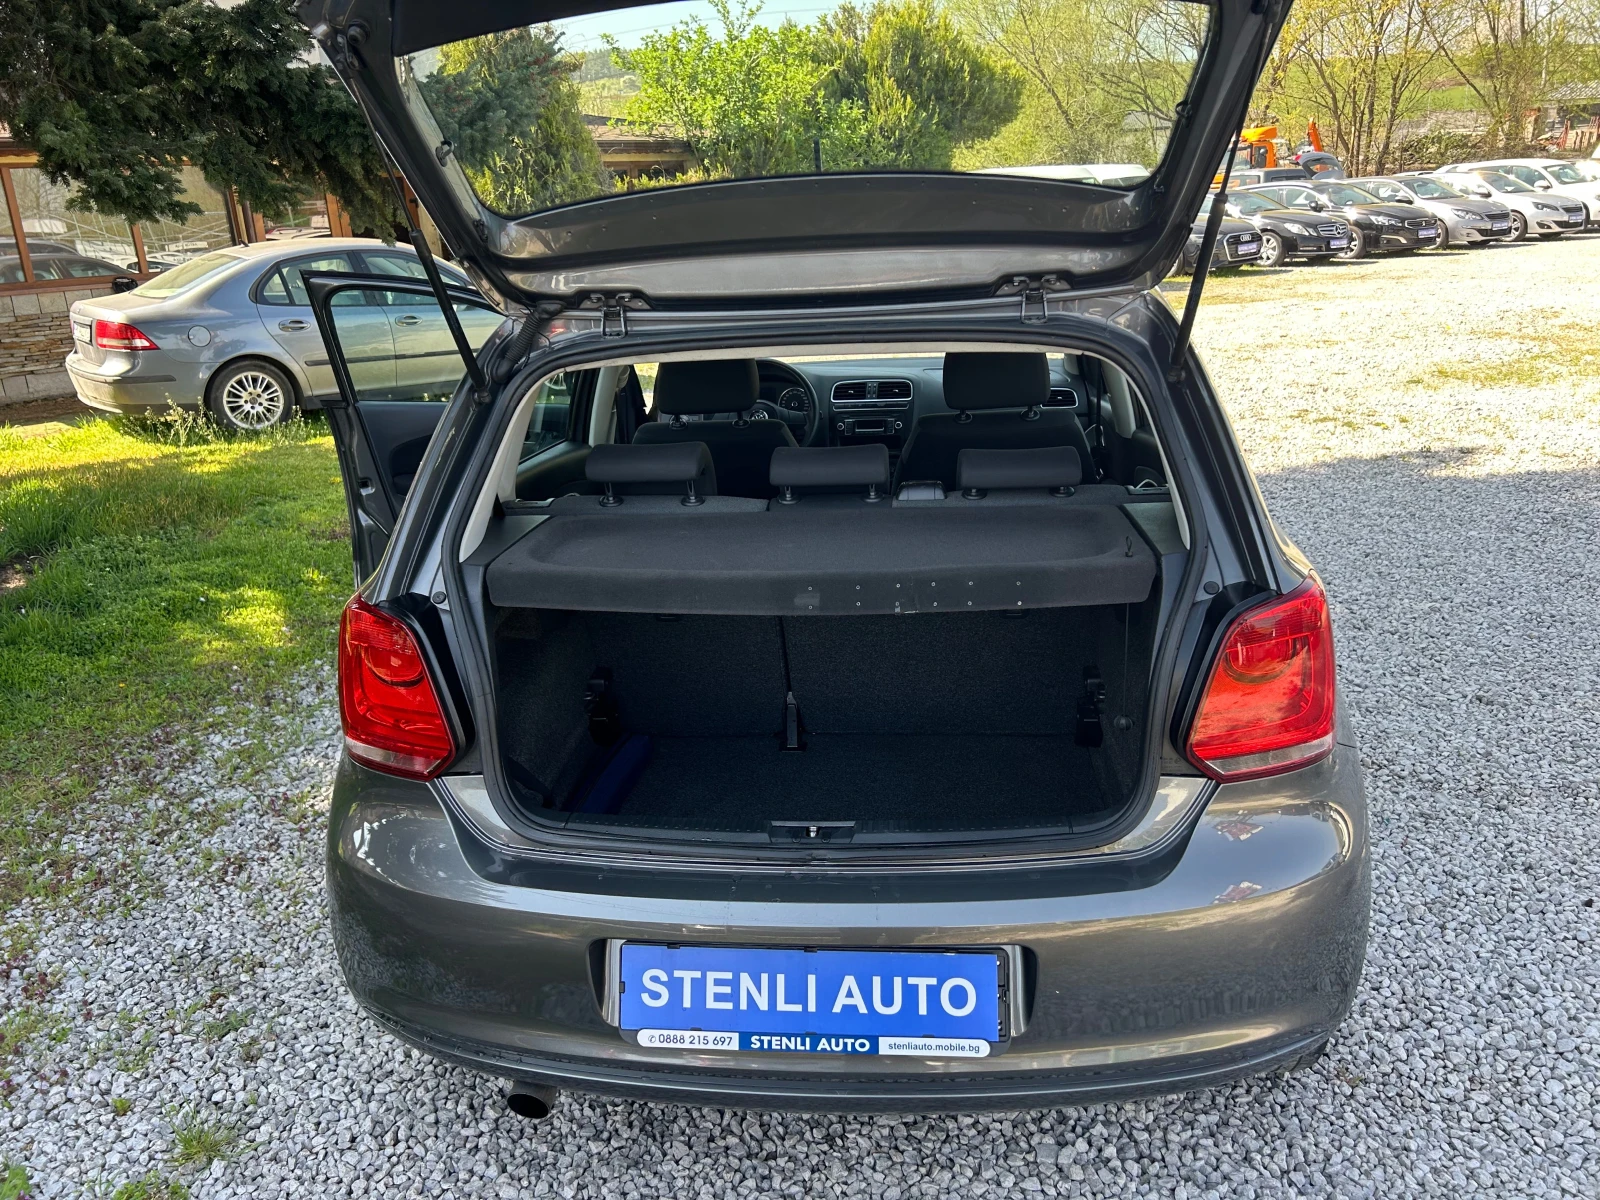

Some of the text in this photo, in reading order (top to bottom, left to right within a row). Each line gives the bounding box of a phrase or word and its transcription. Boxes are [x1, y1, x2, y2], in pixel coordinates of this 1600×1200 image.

[640, 968, 977, 1017] STENLI AUTO
[658, 1033, 733, 1046] 0888 215 697
[750, 1035, 871, 1052] STENLI AUTO
[888, 1041, 980, 1054] stenliauto.mobile.bg
